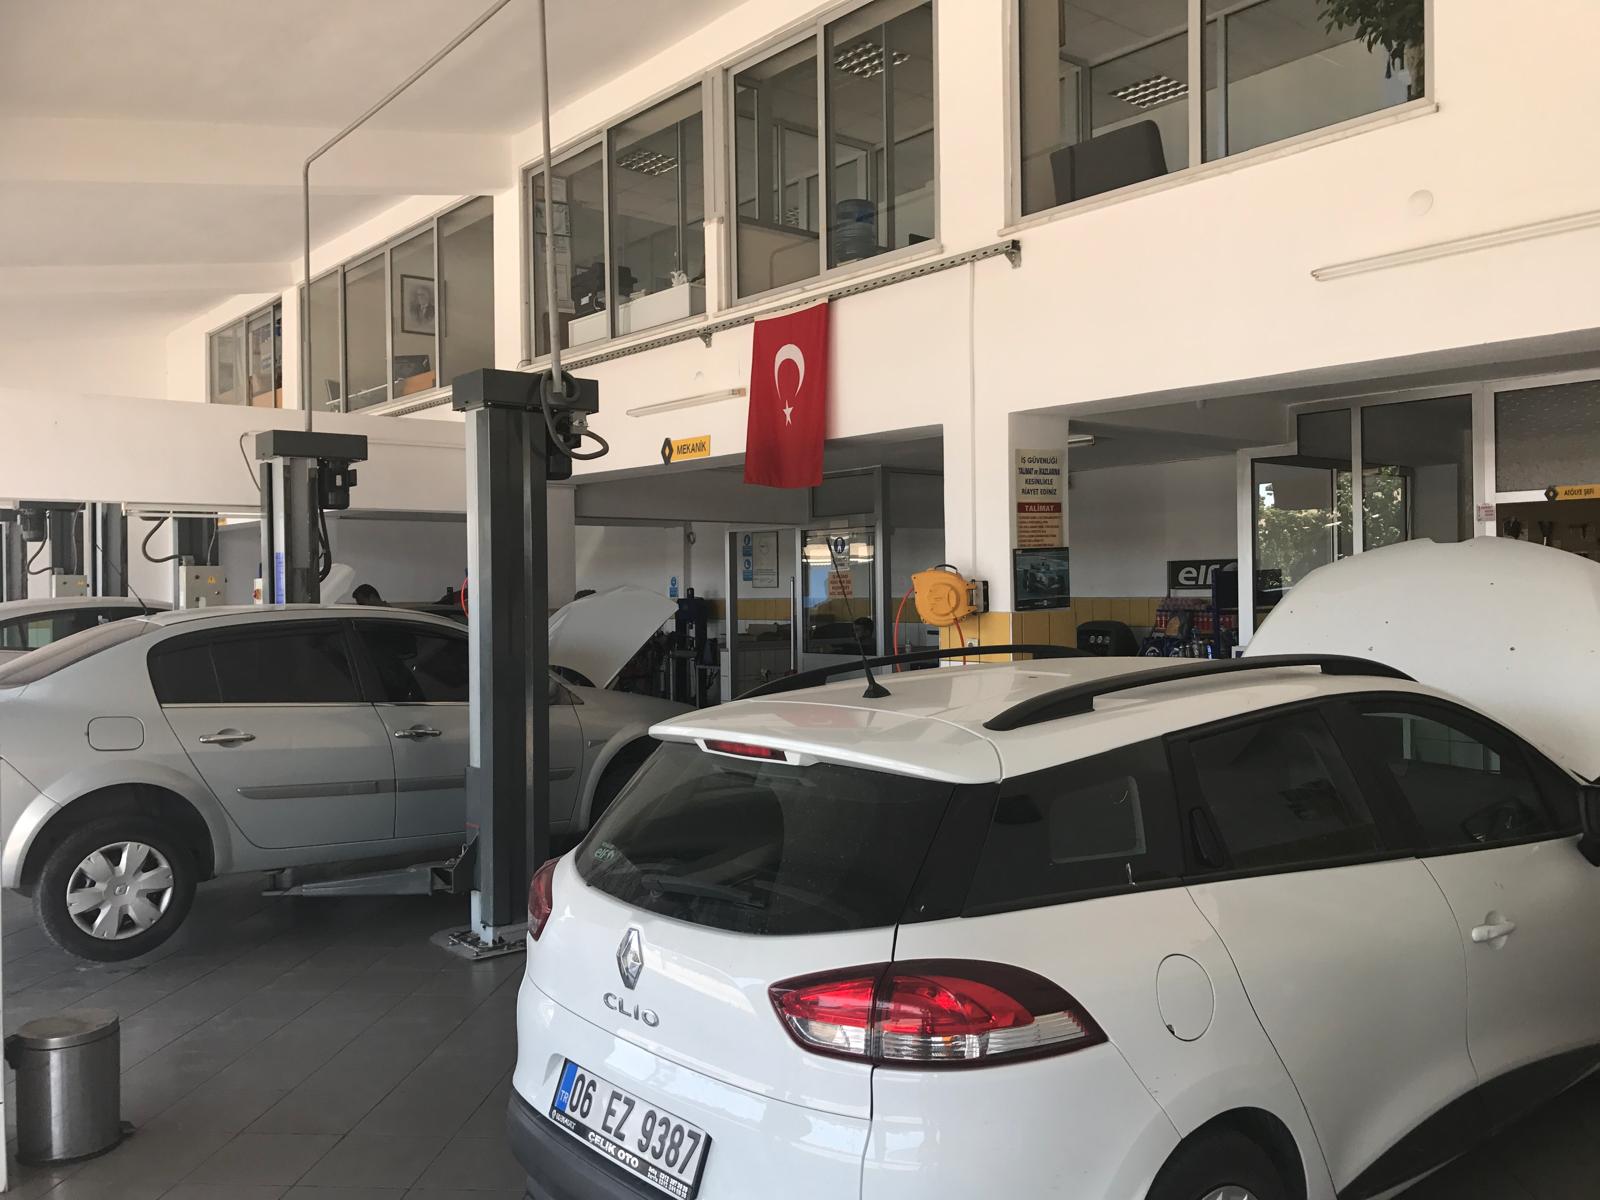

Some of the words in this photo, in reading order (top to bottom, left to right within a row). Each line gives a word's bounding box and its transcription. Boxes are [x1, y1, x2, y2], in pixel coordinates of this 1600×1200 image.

[676, 440, 707, 455] MEKANİK
[603, 992, 660, 1027] CLIO
[560, 1089, 569, 1103] TR
[569, 1073, 597, 1119] 06
[601, 1090, 636, 1141] EZ
[637, 1110, 701, 1175] 9387
[617, 1149, 640, 1169] OTO
